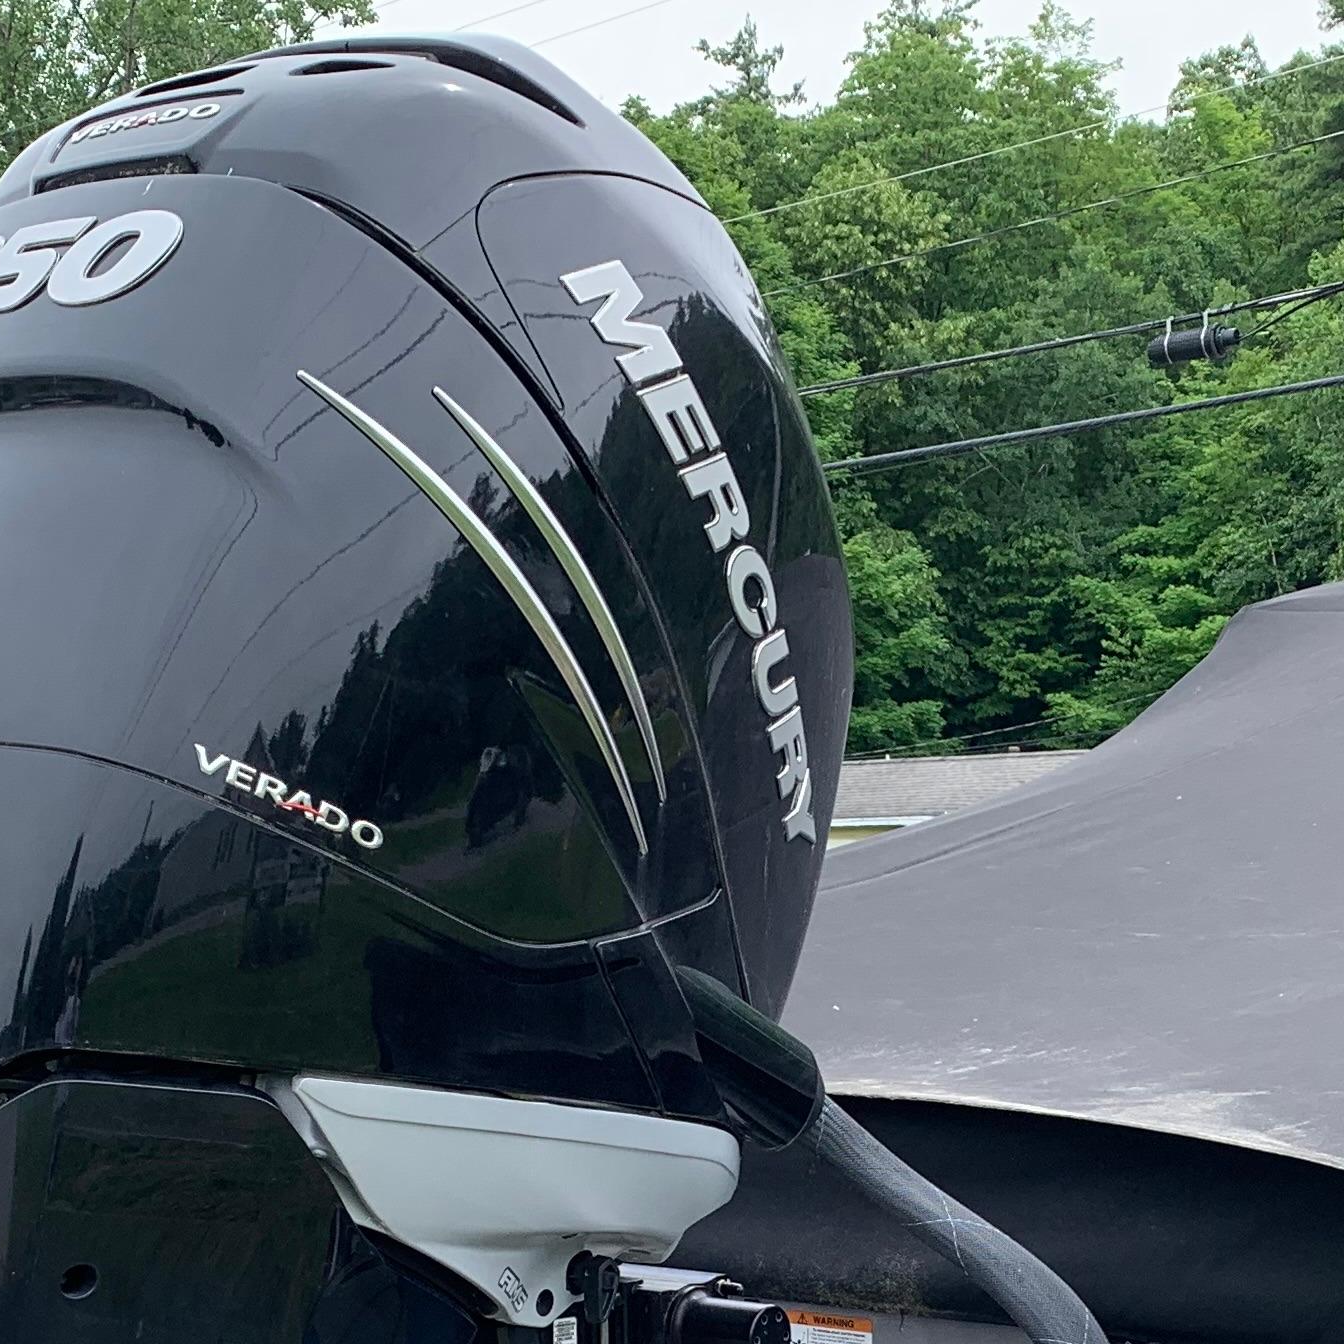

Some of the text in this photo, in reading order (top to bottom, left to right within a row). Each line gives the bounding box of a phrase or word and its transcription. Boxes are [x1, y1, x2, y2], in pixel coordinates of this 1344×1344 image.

[71, 103, 222, 144] VERADO
[558, 259, 819, 845] MERCURY
[193, 743, 385, 851] VERADO
[498, 1266, 529, 1314] AMS
[812, 1315, 855, 1329] WARNING
